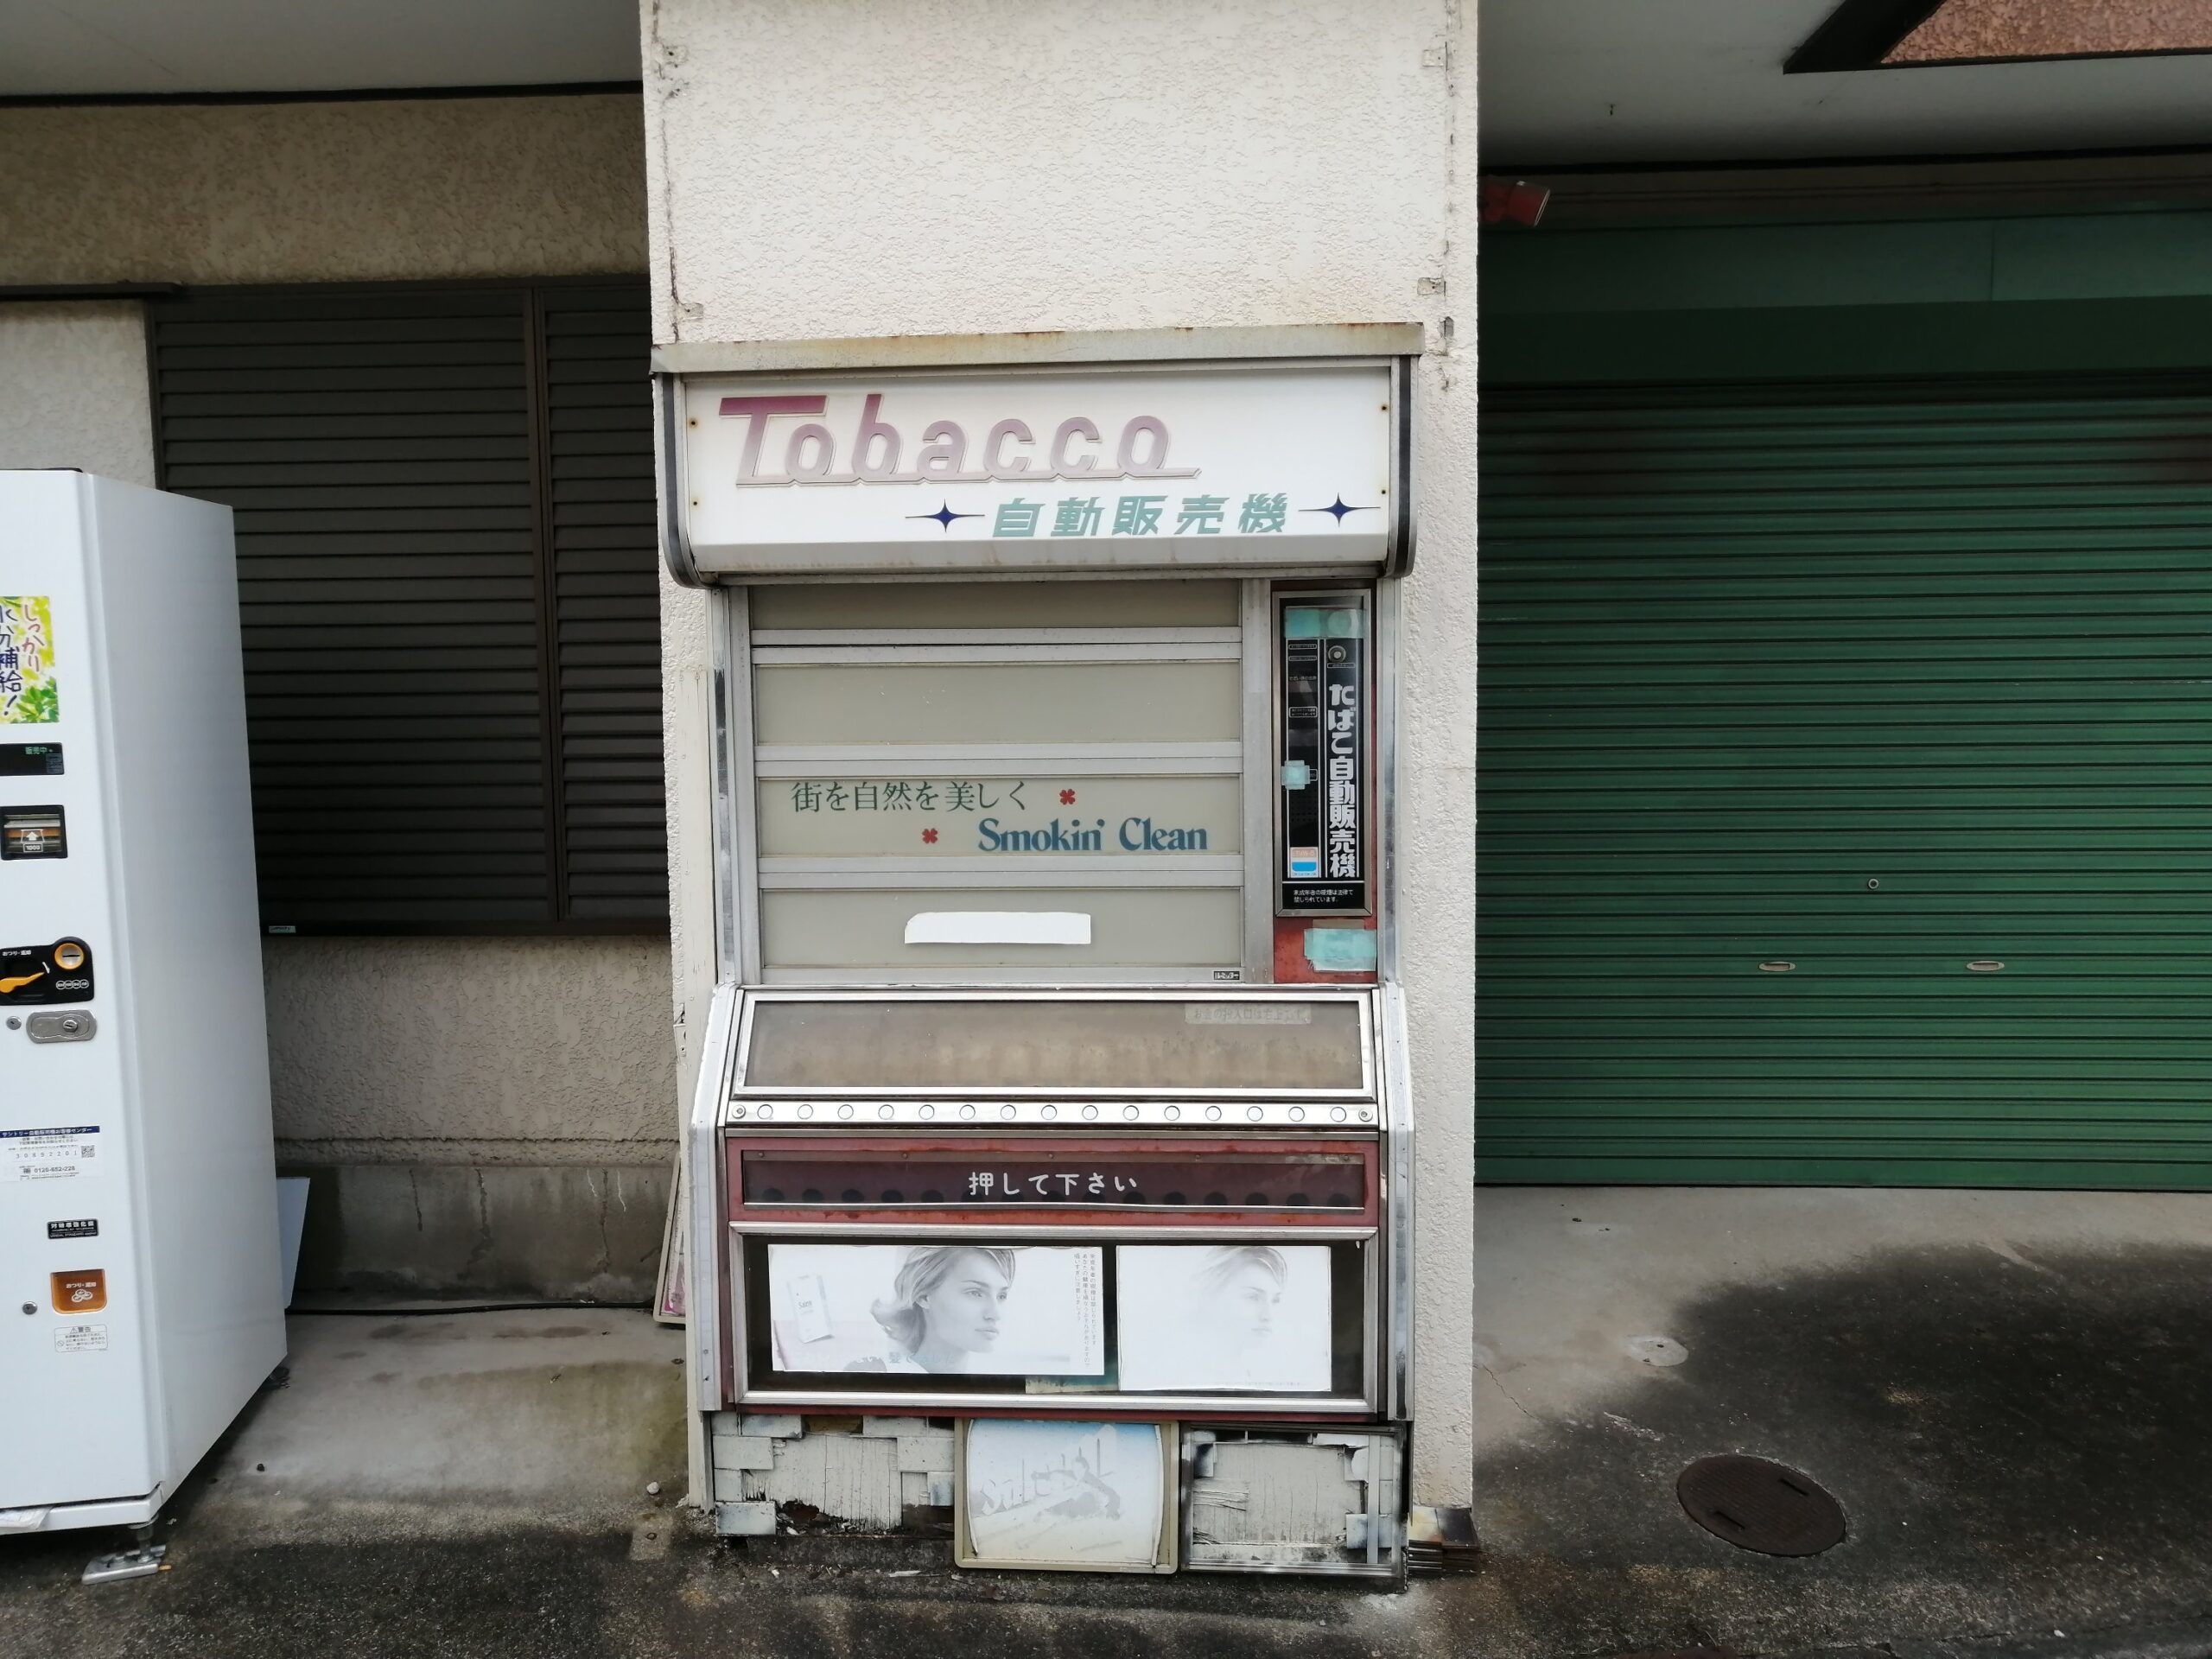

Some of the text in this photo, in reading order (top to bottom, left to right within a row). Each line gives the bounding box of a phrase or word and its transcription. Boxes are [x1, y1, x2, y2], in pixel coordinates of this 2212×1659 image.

[719, 393, 1201, 486] Tobacco
[993, 493, 1290, 537] 自動販売機
[22, 604, 45, 672] しっかり
[791, 780, 1027, 813] 街を自然を美しく
[1327, 683, 1357, 879] たばこ自動販売機
[977, 817, 1208, 851] Smokin' Clean
[968, 1171, 1139, 1198] 押して下さい
